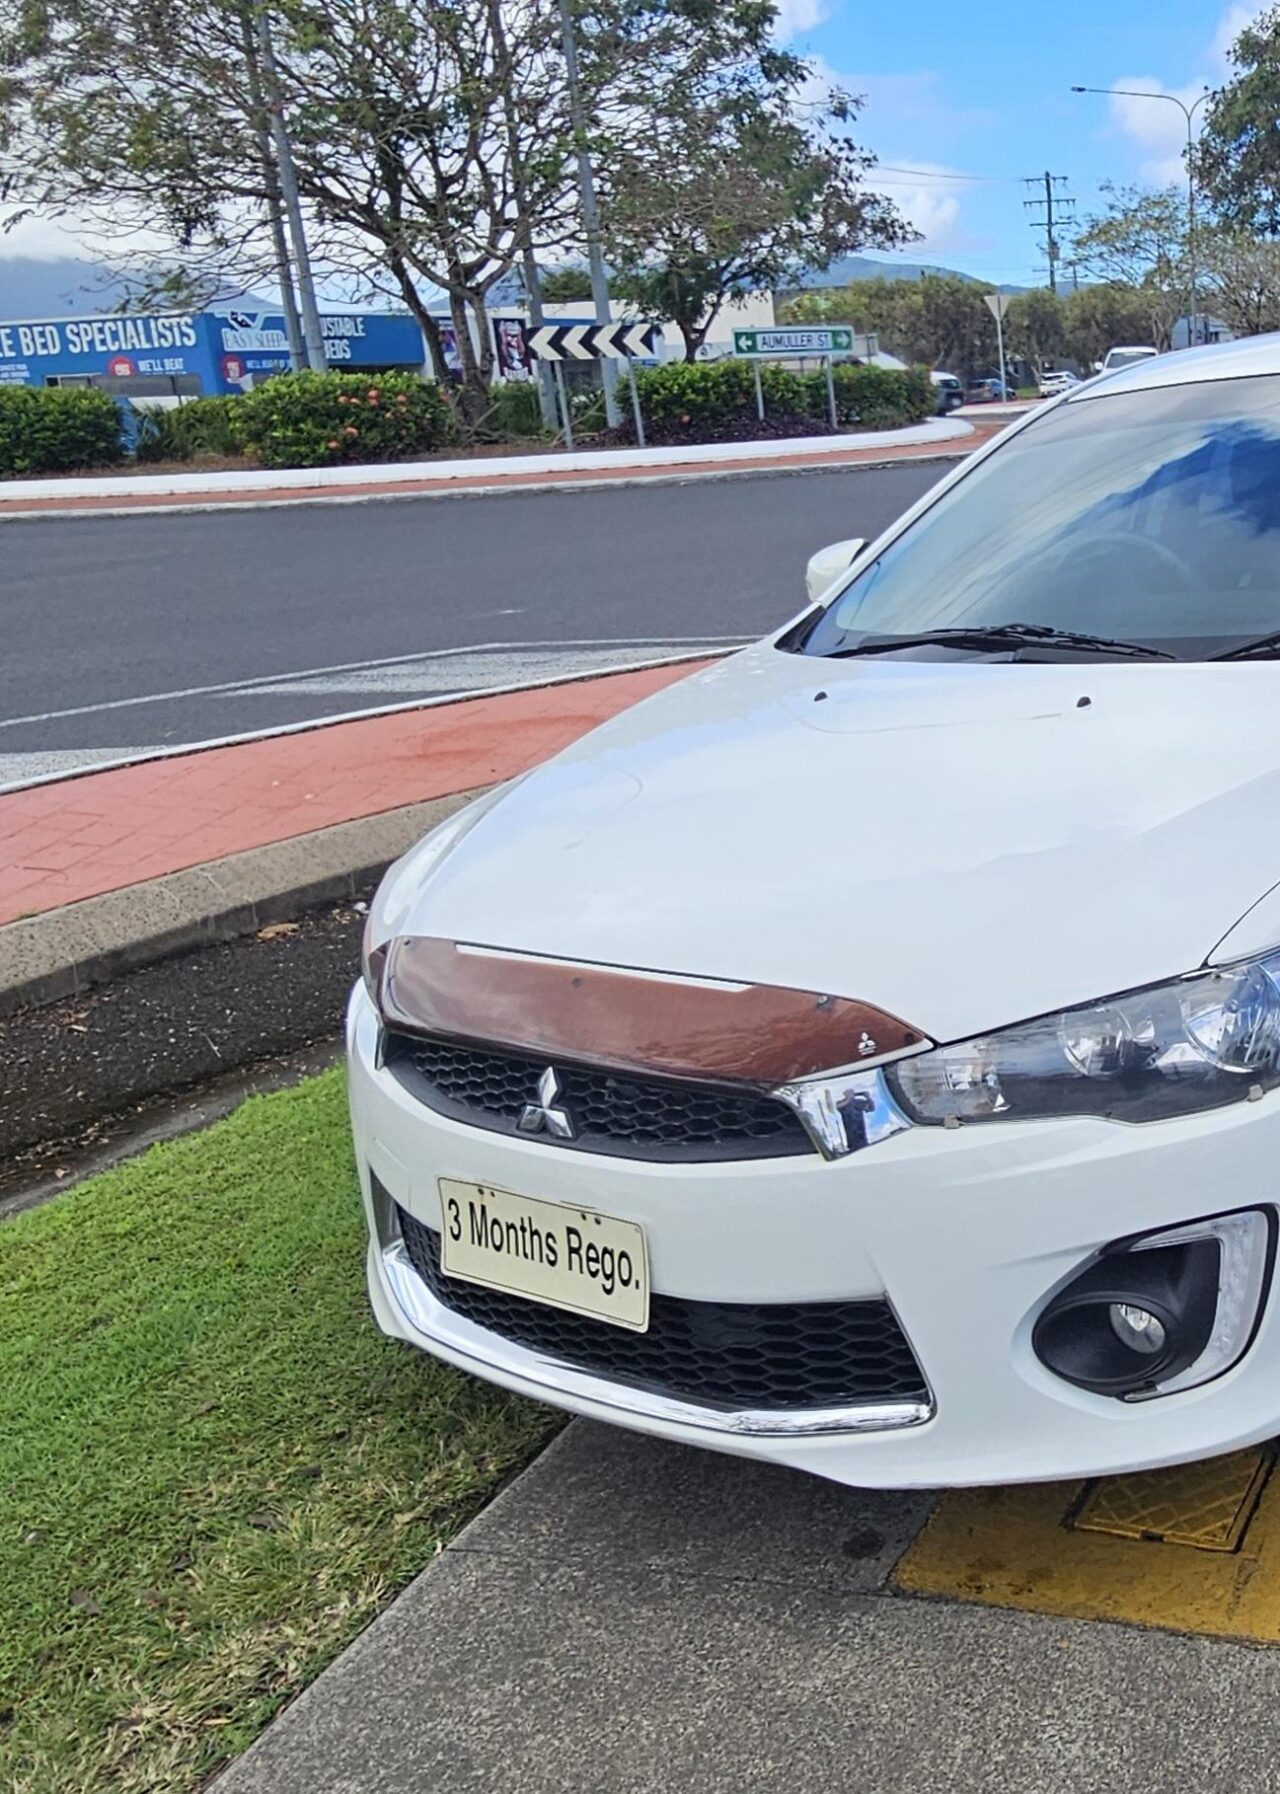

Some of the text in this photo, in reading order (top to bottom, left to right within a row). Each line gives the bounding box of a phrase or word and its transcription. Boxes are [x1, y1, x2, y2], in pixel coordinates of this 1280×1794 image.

[18, 325, 61, 356] BED
[65, 316, 196, 353] SPECIALISTS
[761, 333, 829, 349] AUMULLER ST
[447, 1197, 641, 1296] 3 Months Rego.
